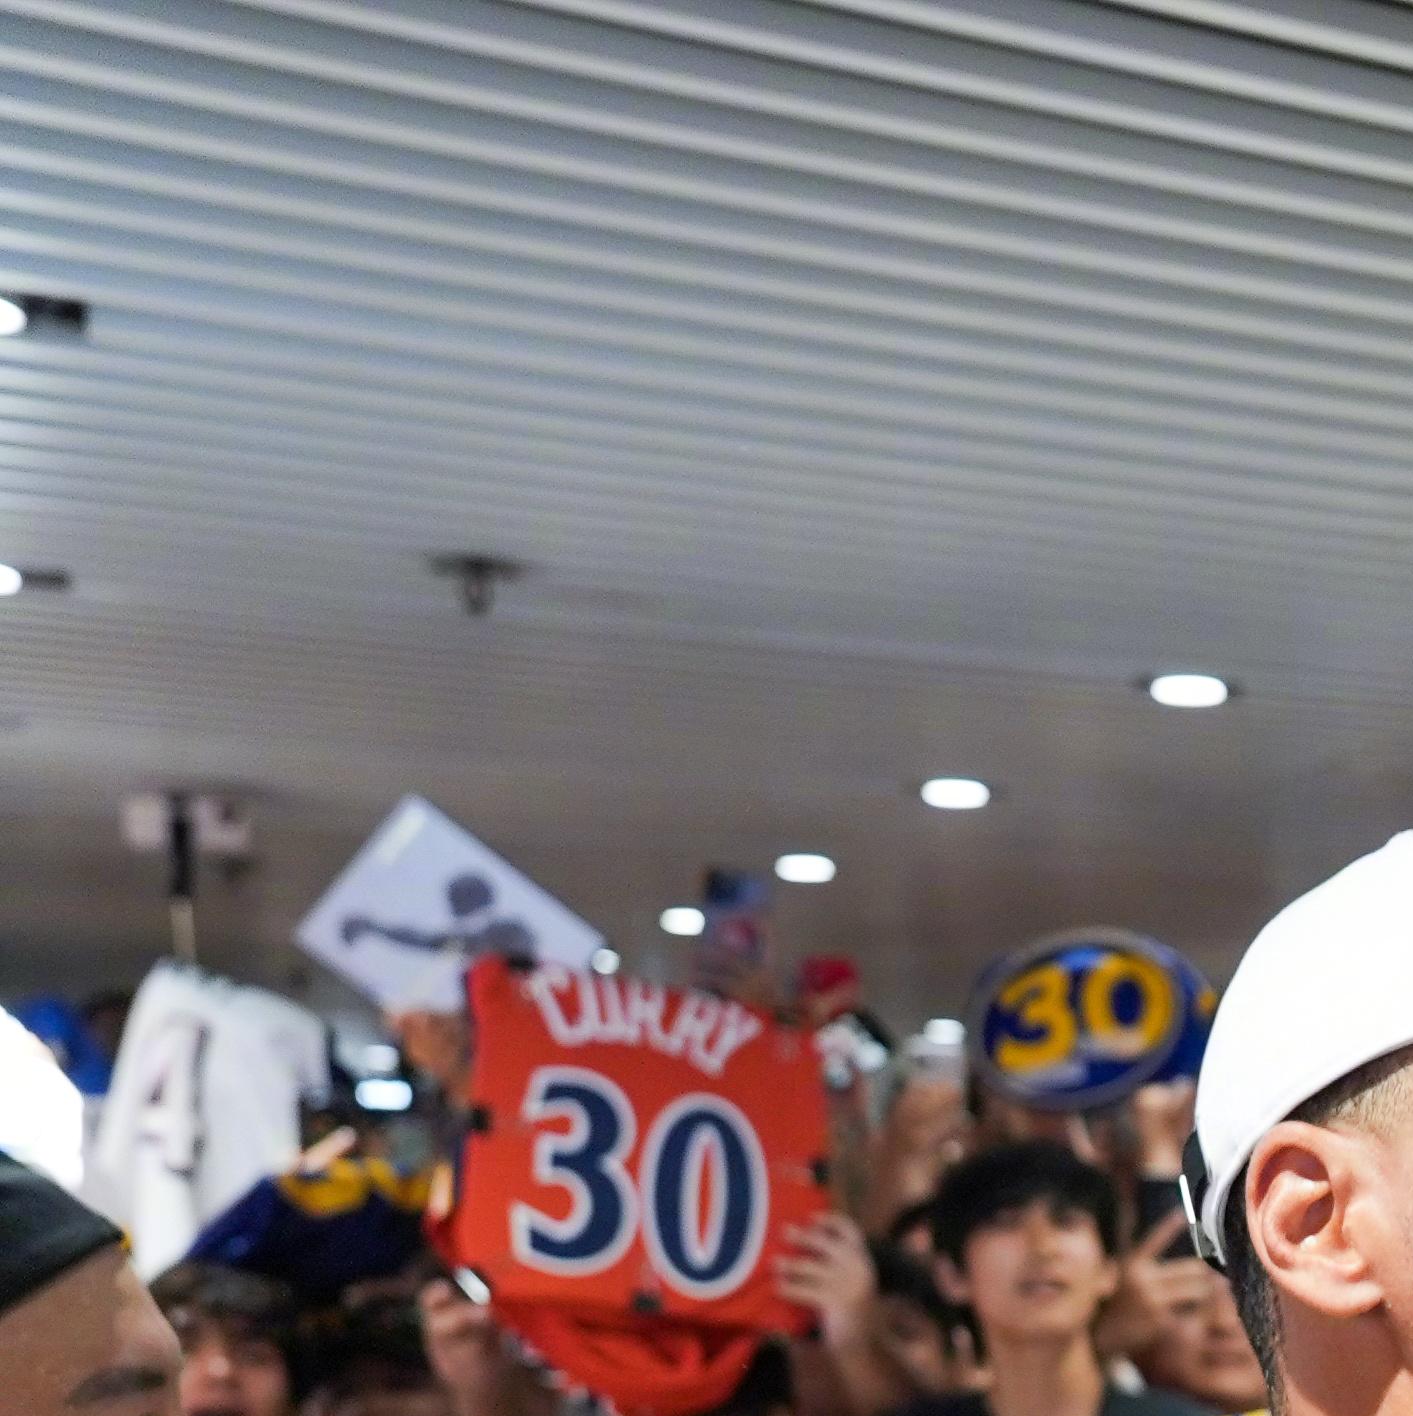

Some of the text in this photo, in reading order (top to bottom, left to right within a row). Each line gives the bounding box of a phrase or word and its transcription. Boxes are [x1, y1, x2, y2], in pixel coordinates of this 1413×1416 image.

[521, 966, 766, 1078] CURRY
[998, 951, 1175, 1072] 30
[511, 1064, 769, 1299] 30
